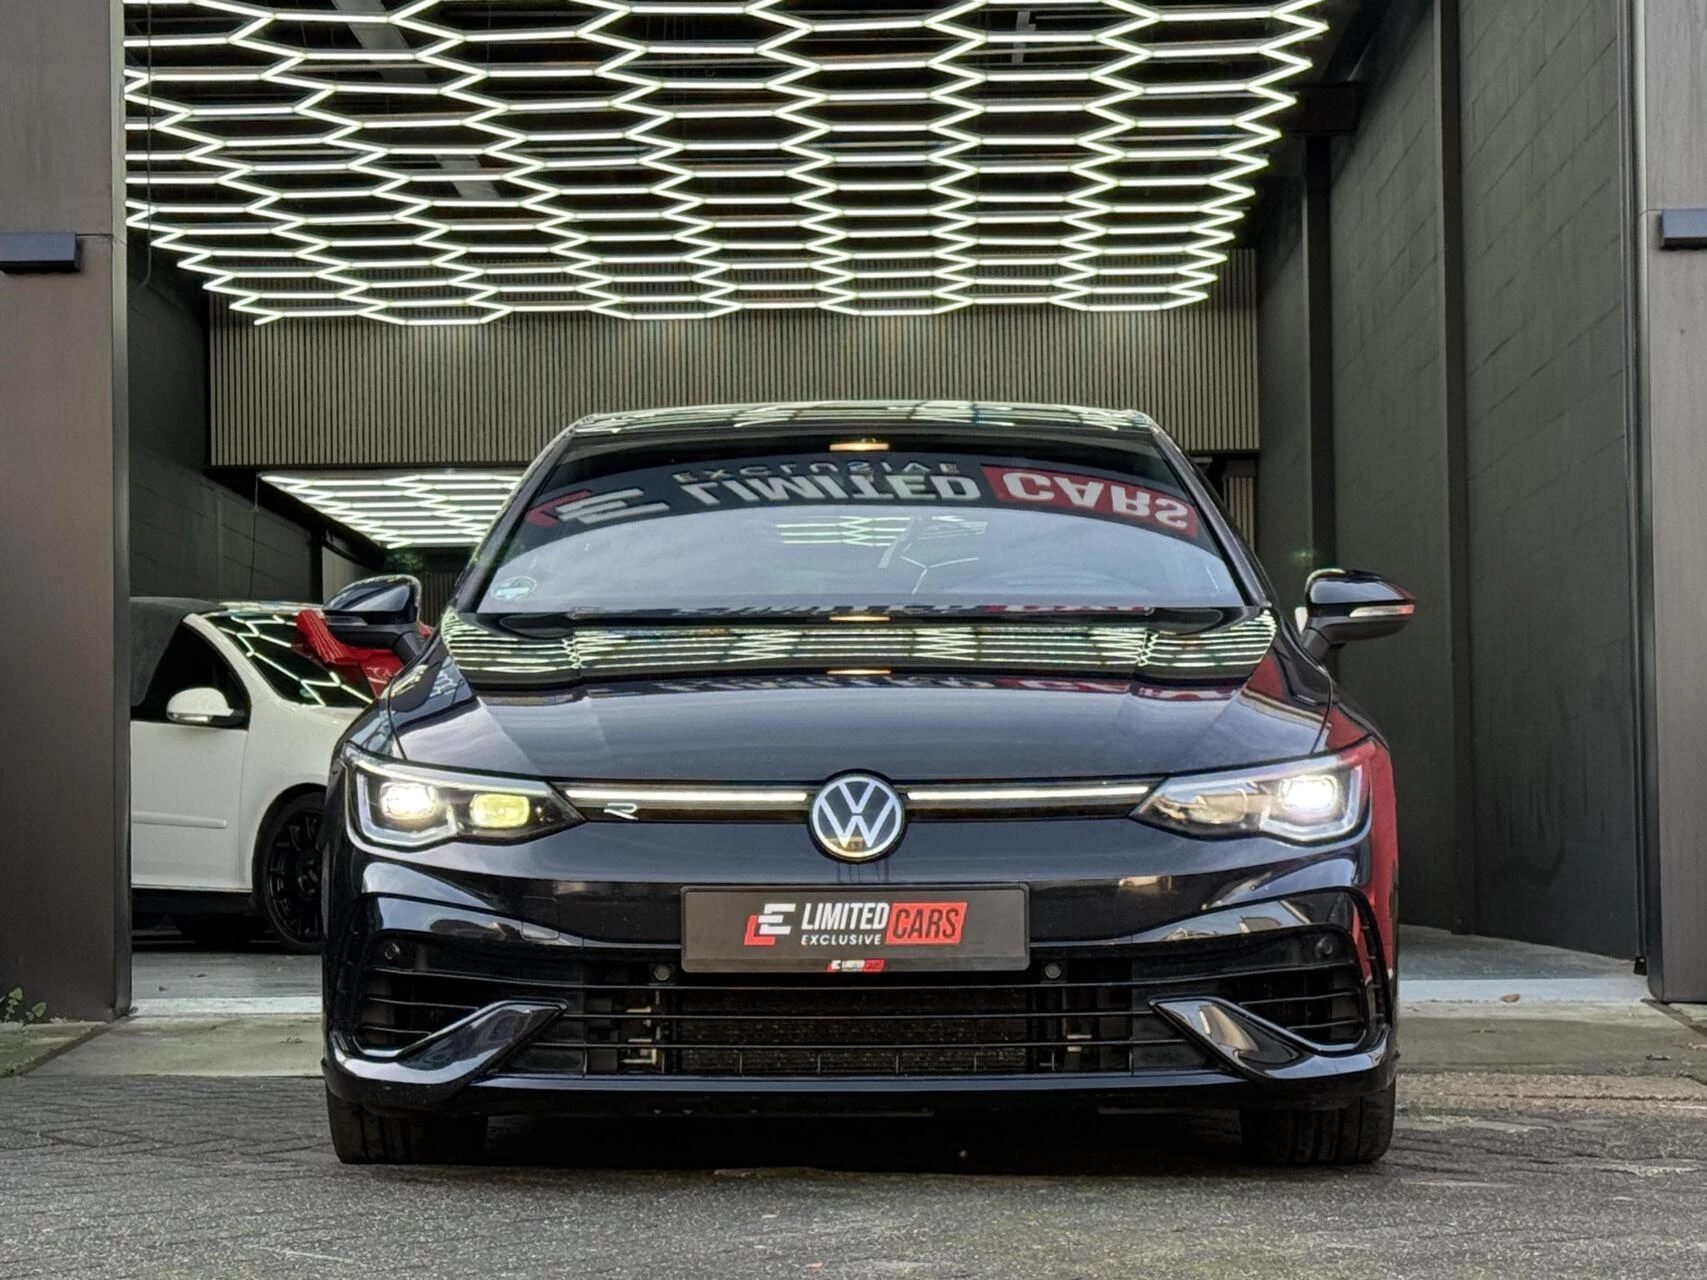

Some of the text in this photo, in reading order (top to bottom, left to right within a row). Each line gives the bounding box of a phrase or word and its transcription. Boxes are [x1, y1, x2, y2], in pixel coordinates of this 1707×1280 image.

[801, 902, 890, 930] LIMITED
[892, 908, 959, 938] CARS
[801, 934, 882, 945] EXCLUSIVE
